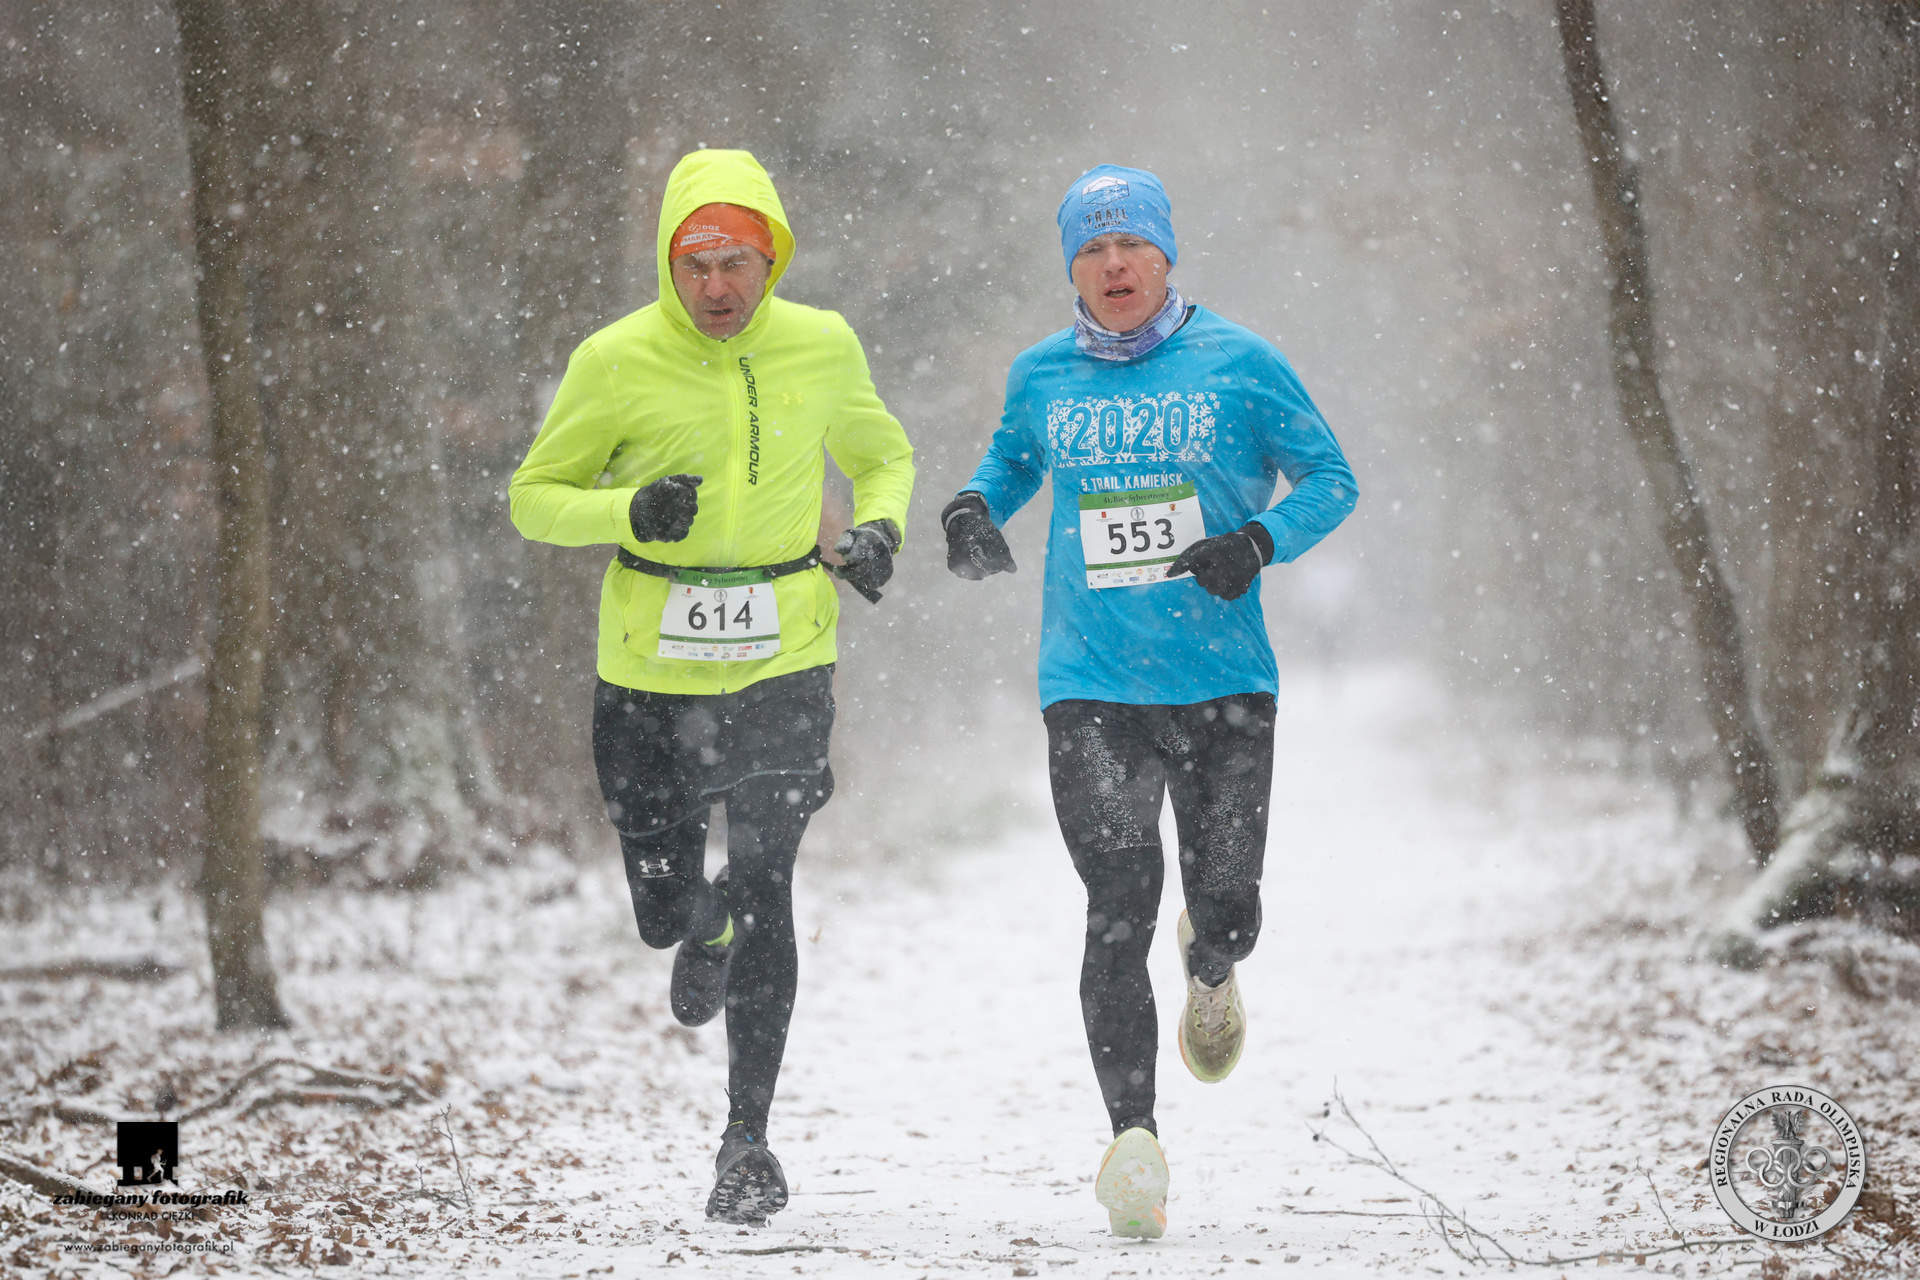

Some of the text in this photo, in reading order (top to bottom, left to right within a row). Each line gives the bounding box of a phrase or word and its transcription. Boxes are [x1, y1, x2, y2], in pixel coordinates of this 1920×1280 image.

[1086, 208, 1128, 225] TRAIL
[739, 356, 760, 486] UNDER ARMOUR
[1066, 399, 1191, 460] 2020
[1124, 470, 1184, 489] KAMIEŃSK
[1107, 518, 1175, 555] 553
[688, 600, 753, 631] 614
